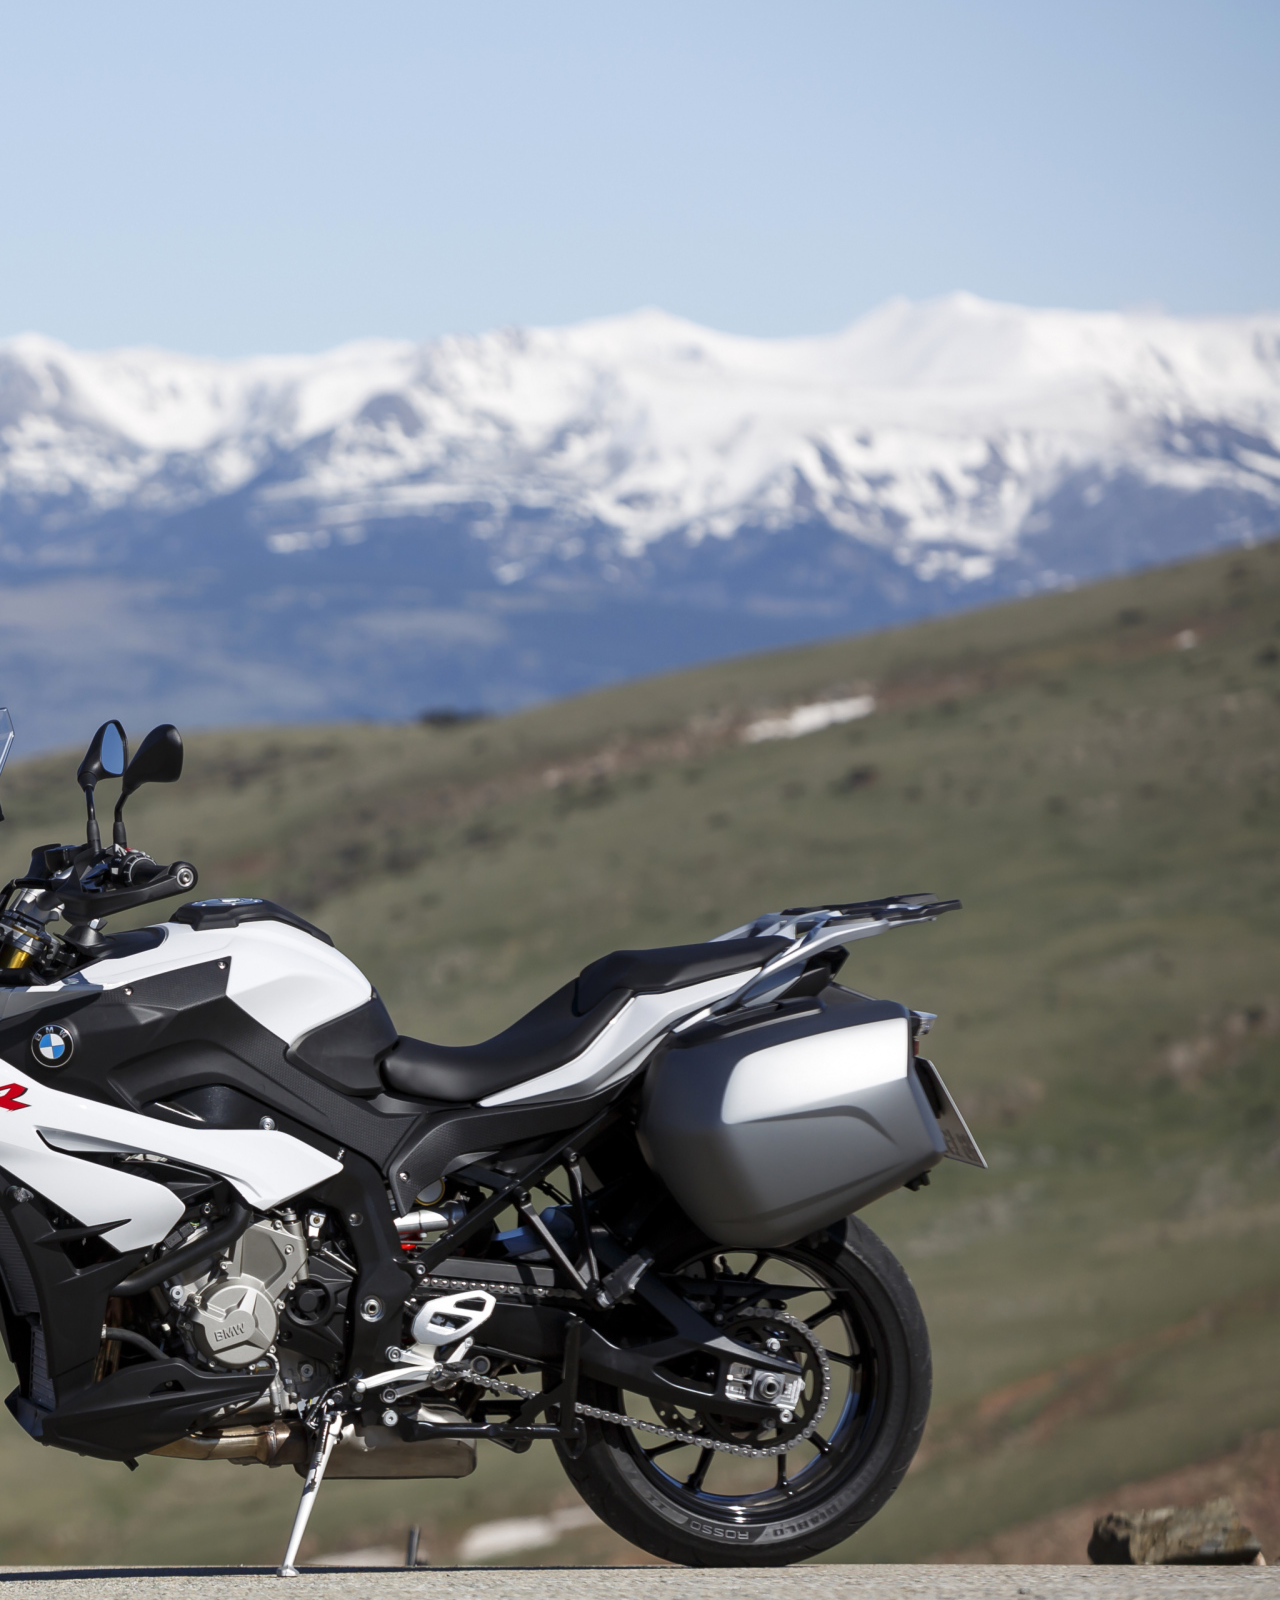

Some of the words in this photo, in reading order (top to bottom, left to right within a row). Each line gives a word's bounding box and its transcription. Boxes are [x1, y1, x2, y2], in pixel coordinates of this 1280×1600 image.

[34, 1026, 68, 1042] BMW
[214, 1322, 245, 1342] BMW
[689, 1520, 749, 1541] ROSSO
[772, 1503, 841, 1538] DIABLO
